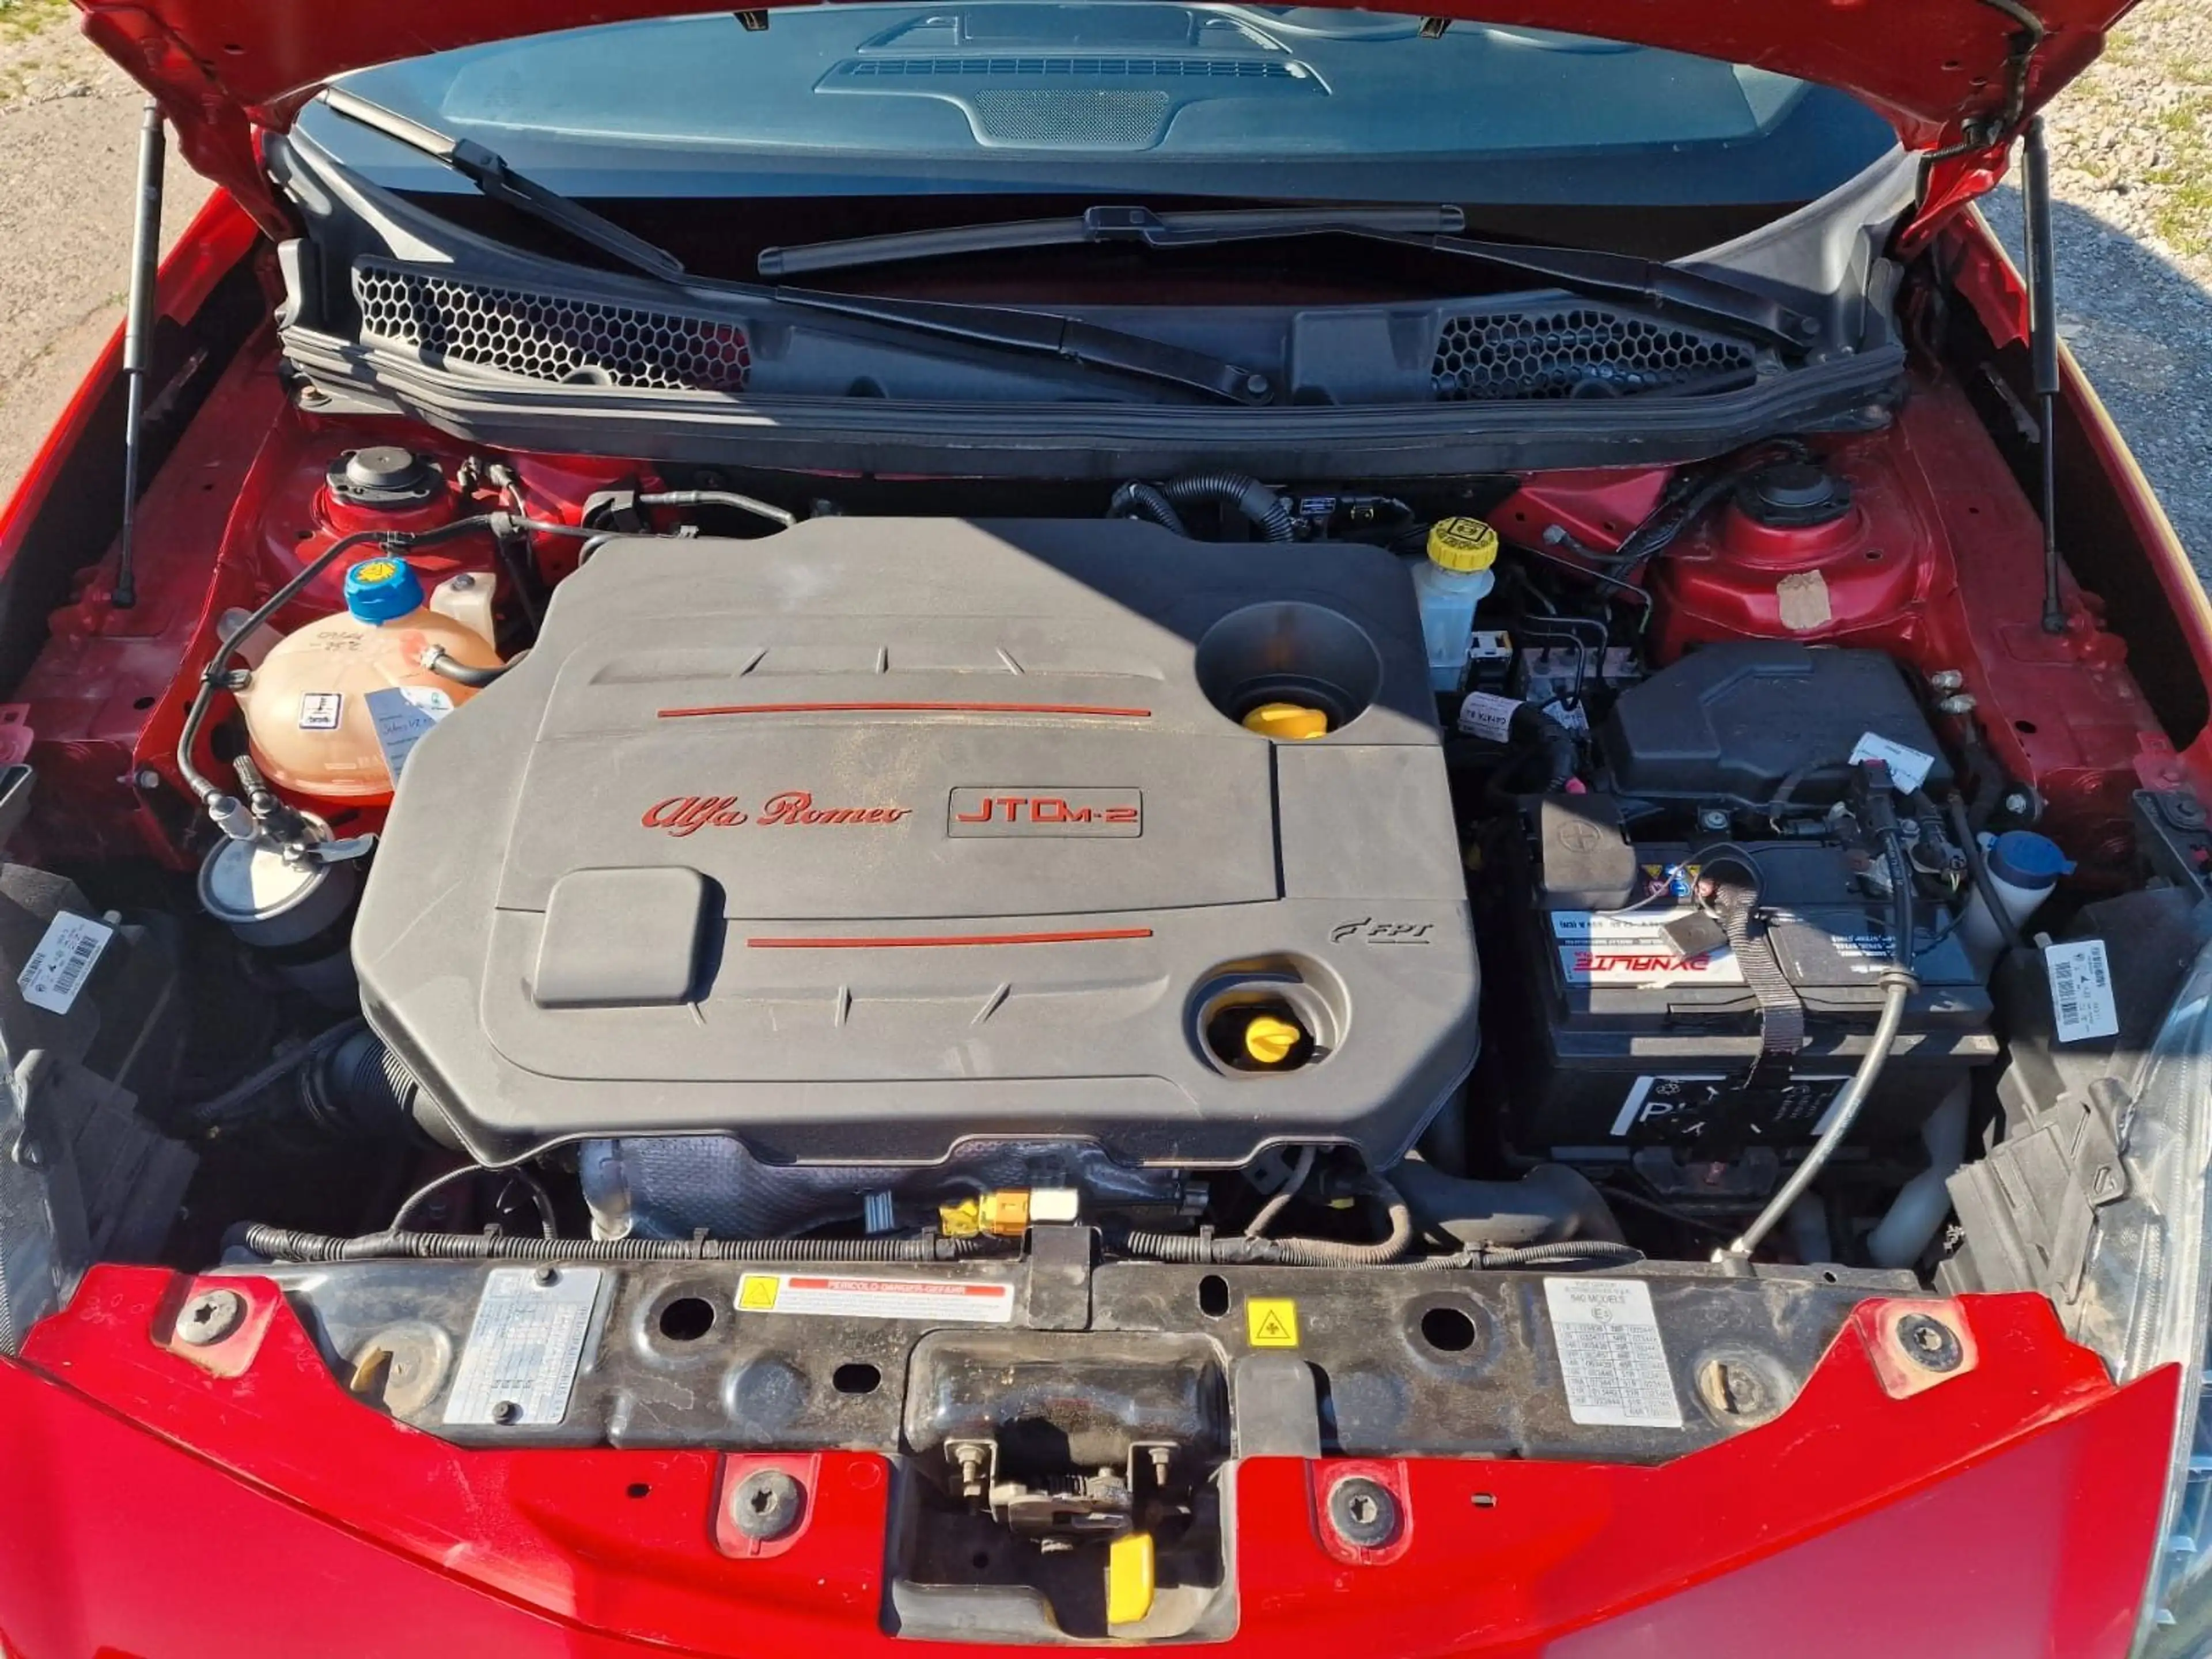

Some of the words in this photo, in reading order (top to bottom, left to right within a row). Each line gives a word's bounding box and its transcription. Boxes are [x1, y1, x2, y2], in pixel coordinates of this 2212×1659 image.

[642, 796, 748, 836] Alfa
[757, 791, 911, 827] Romeo
[1575, 955, 1712, 971] DYNALITE
